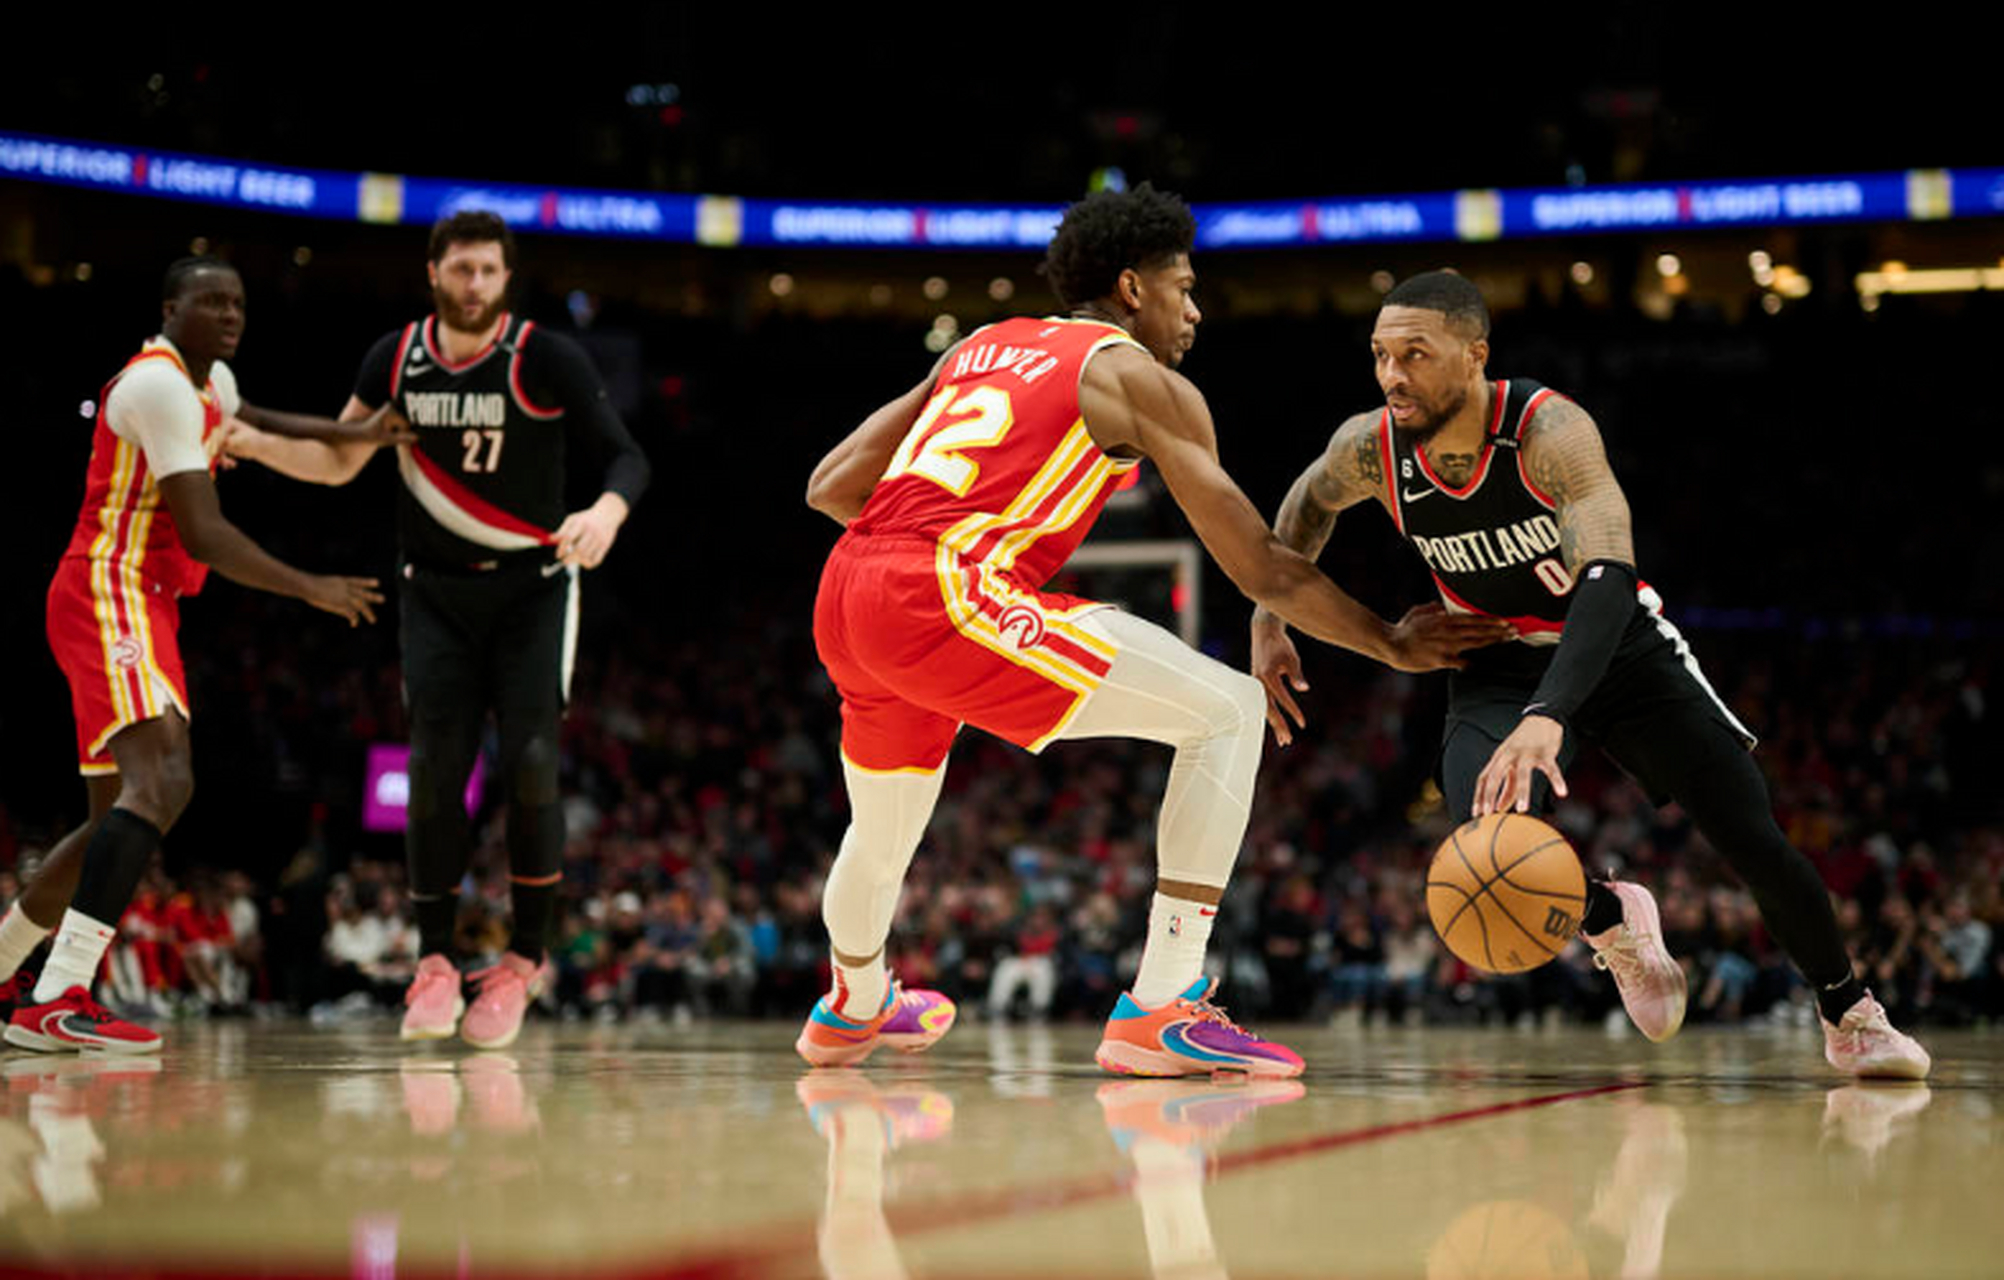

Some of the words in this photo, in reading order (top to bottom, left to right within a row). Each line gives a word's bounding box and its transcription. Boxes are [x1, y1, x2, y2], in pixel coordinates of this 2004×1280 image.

[0, 138, 131, 185] UPERIOR
[149, 158, 236, 196] LIGHT
[239, 168, 315, 208] BEER
[771, 206, 913, 242] SUPERIOR
[926, 208, 1012, 244] LIGHT
[1532, 189, 1678, 229] SUPERIOR
[1689, 184, 1781, 222] LIGHT
[1783, 181, 1863, 218] BEER
[404, 391, 505, 427] PORTLAND
[461, 430, 504, 473] 27
[880, 384, 1015, 498] 12
[1401, 458, 1414, 479] 6
[1411, 514, 1561, 573] PORTLAND
[1534, 557, 1574, 597] 0
